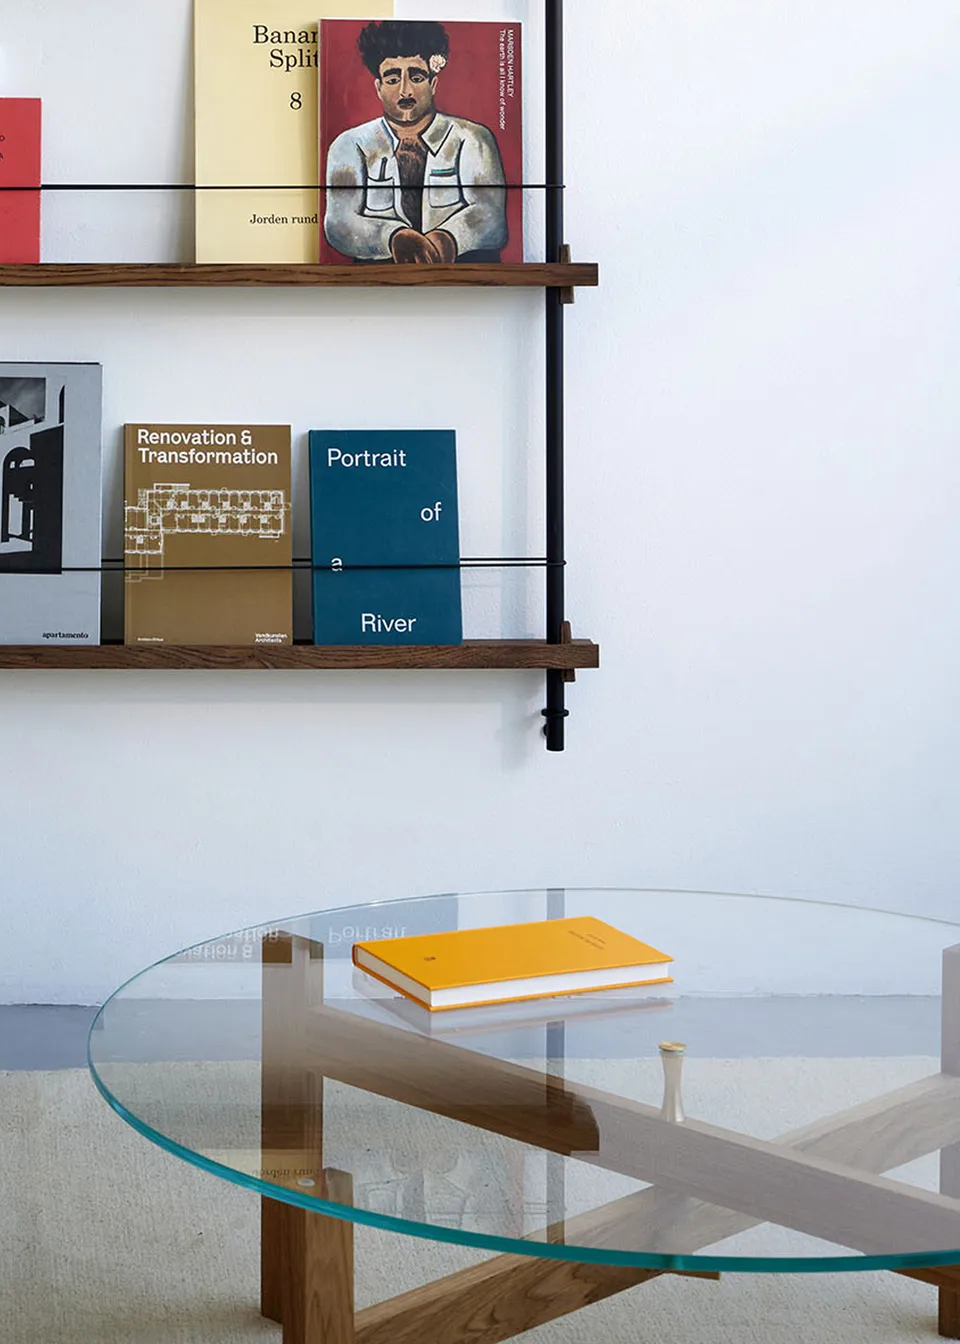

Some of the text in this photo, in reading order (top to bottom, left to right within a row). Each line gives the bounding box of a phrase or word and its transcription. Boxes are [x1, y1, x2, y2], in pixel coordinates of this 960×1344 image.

[269, 48, 319, 72] Split
[507, 65, 515, 97] HARTLEY
[289, 91, 302, 111] 8
[499, 97, 506, 105] of
[249, 213, 318, 226] Jorden rund
[137, 428, 253, 446] Renovation &
[137, 447, 279, 465] Transformation
[327, 447, 407, 468] Portrait
[420, 501, 442, 522] of
[330, 557, 343, 572] a
[360, 612, 417, 633] River
[41, 631, 89, 640] apartamento
